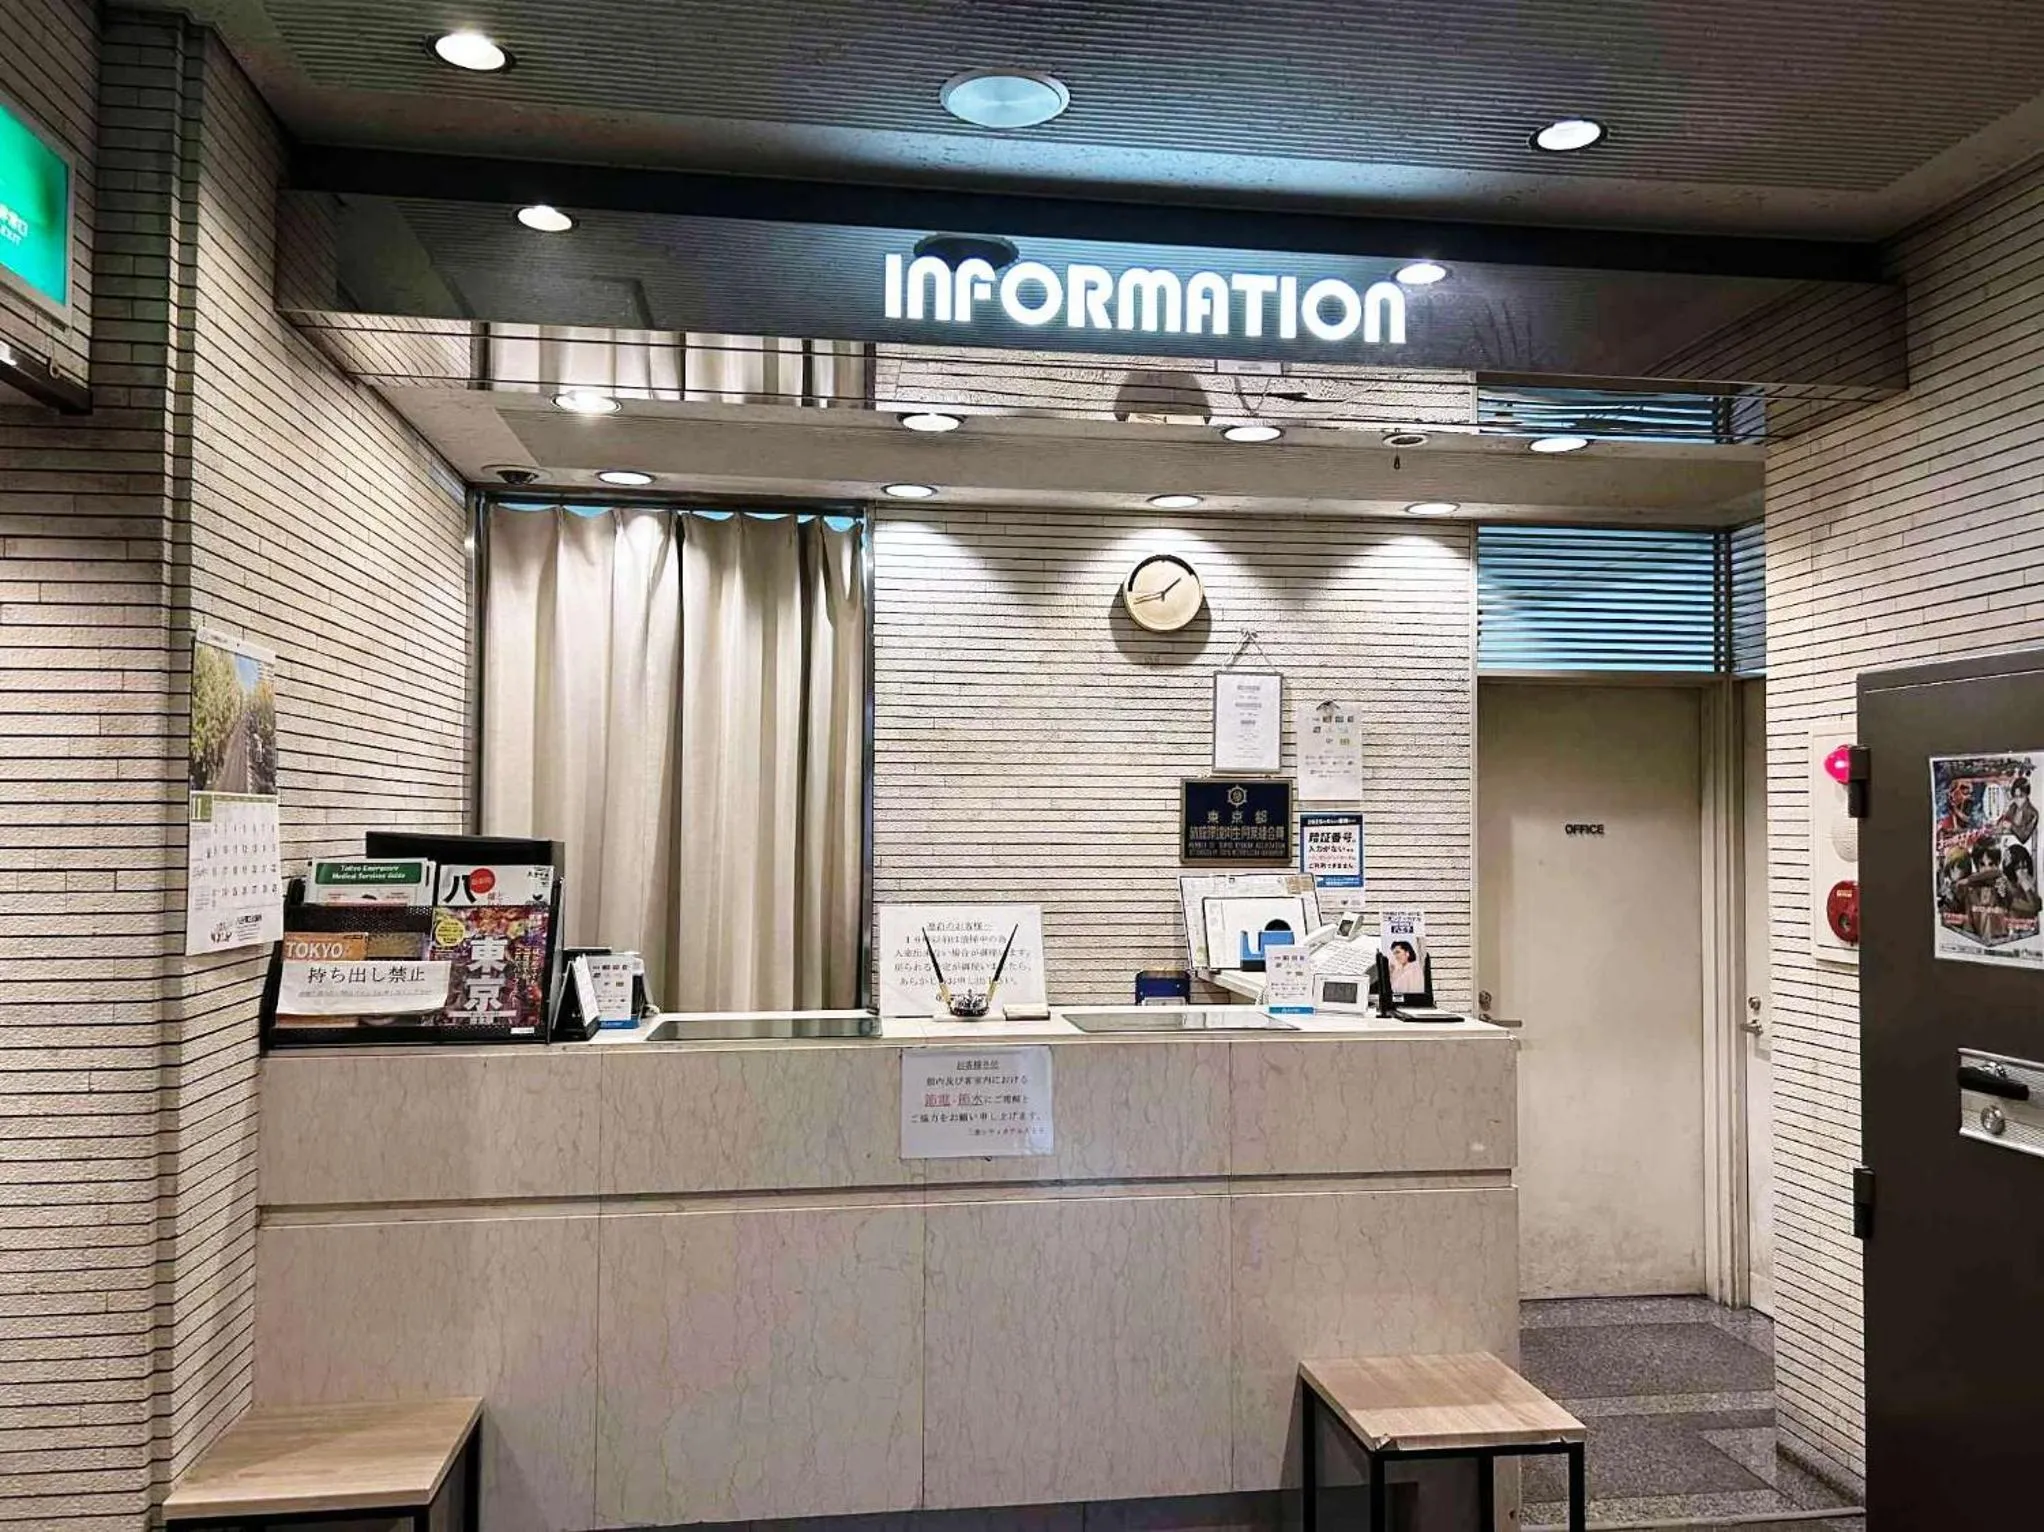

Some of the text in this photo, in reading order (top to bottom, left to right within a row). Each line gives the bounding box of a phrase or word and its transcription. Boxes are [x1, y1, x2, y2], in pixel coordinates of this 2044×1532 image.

[885, 253, 1407, 344] INFORMATION
[1565, 824, 1605, 835] OFFICE
[285, 941, 344, 959] TOKYO
[307, 965, 426, 984] 持ち出し禁止
[463, 935, 508, 1010] 東京
